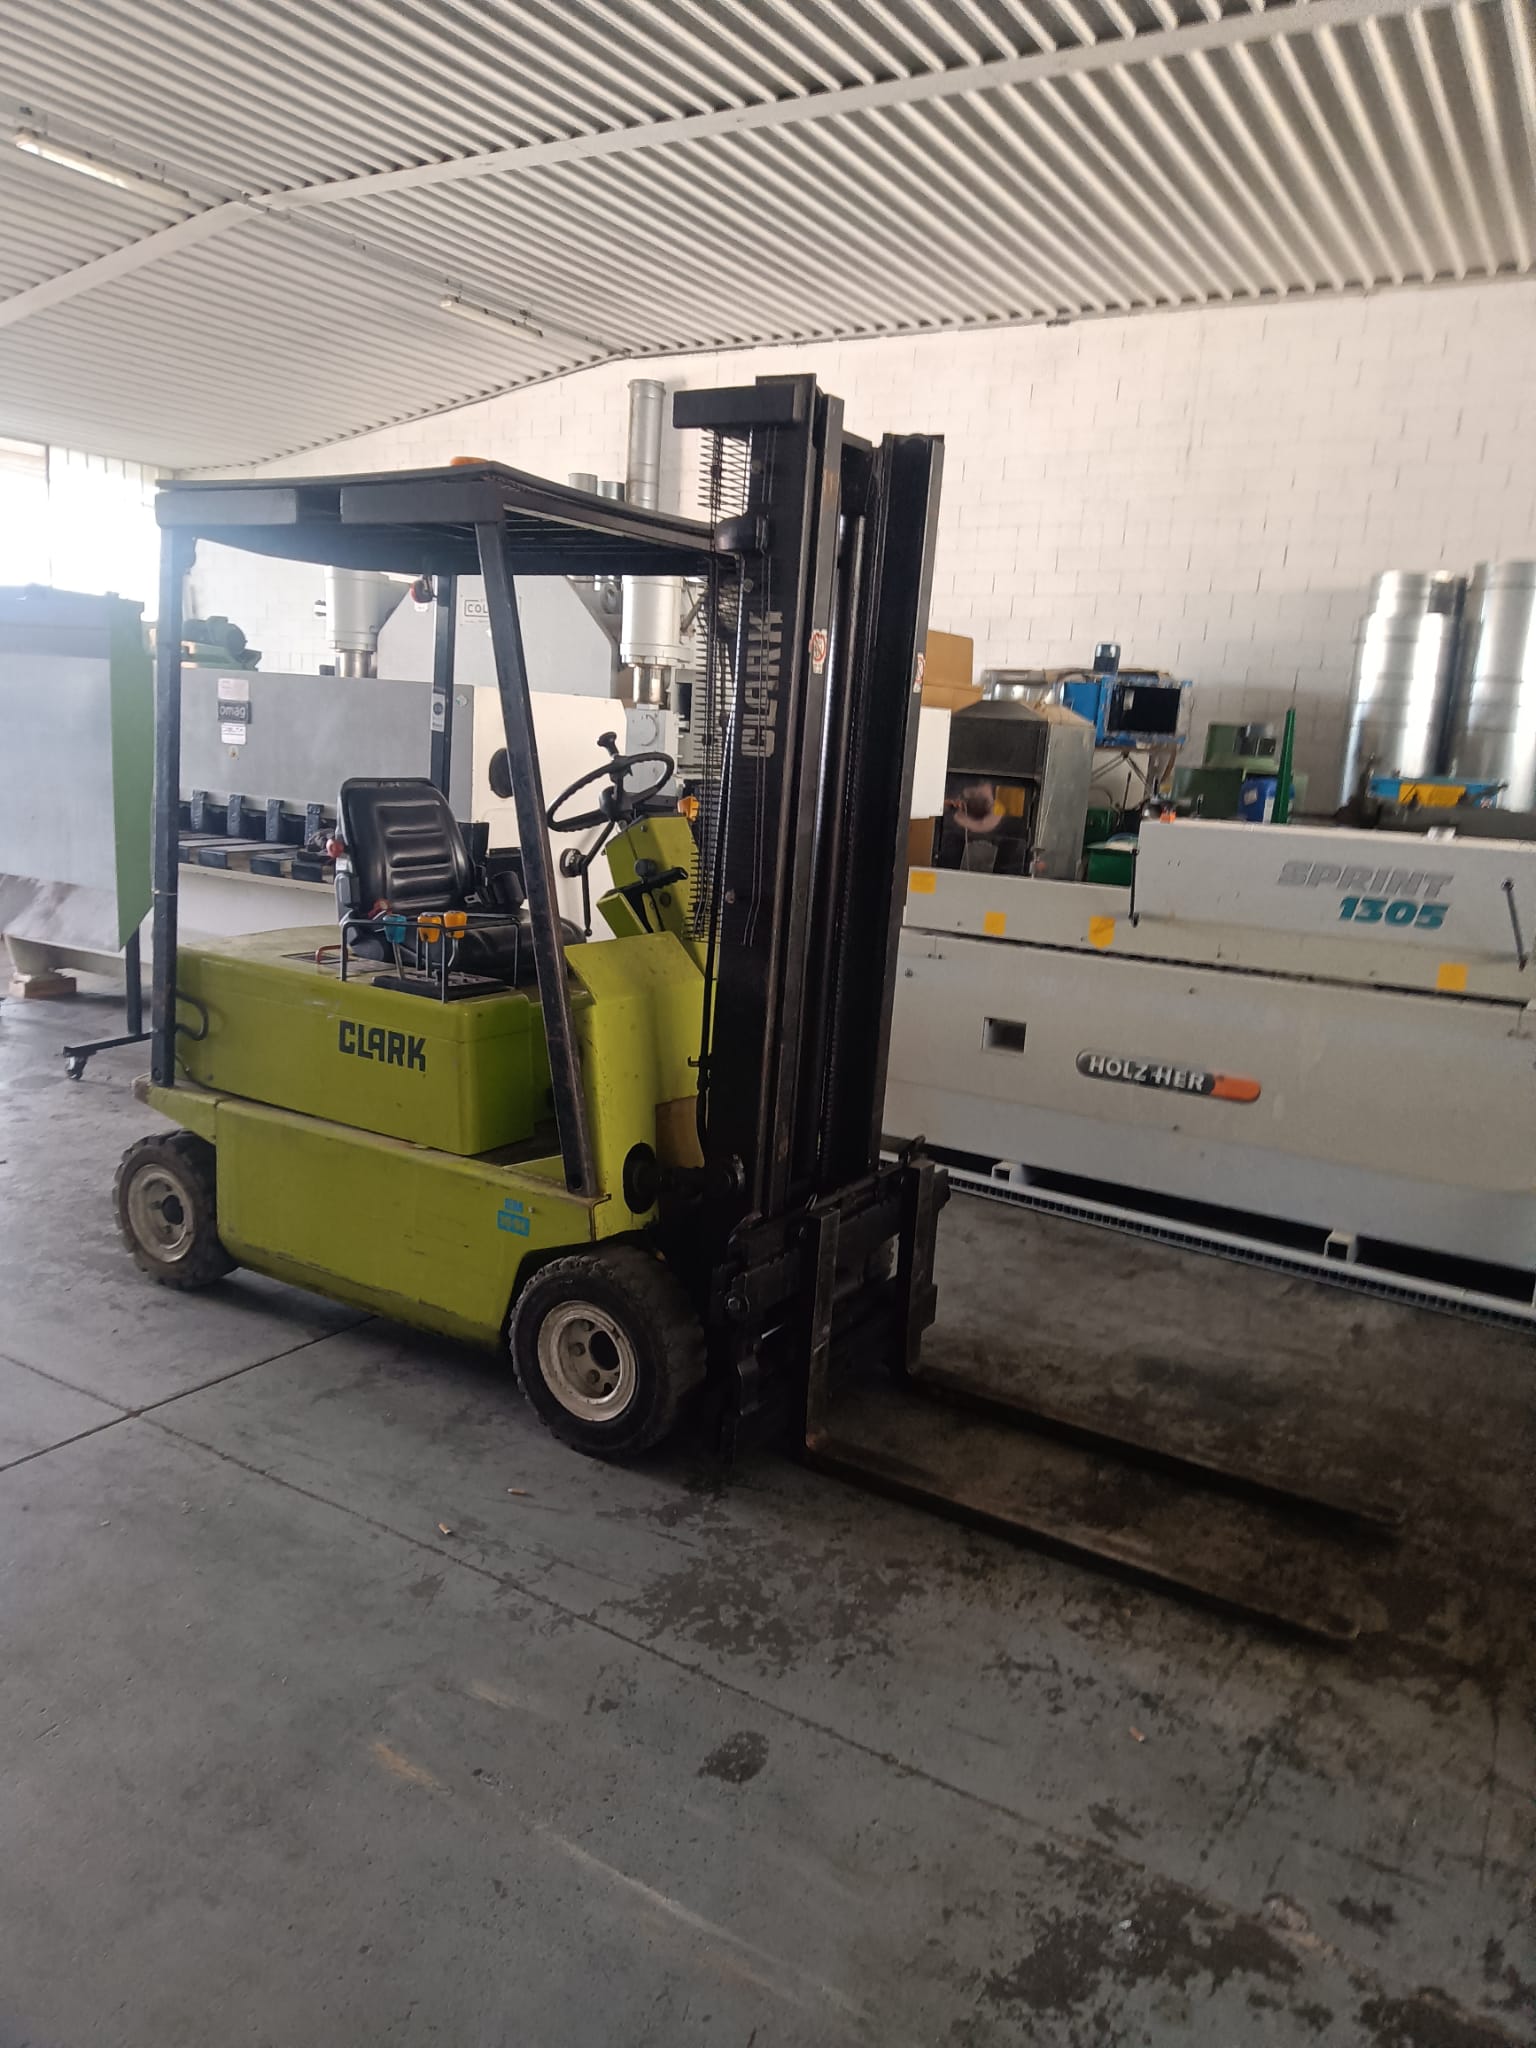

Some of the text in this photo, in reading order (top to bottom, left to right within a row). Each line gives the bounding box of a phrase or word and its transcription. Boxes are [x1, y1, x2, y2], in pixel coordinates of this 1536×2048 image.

[467, 603, 489, 614] COL
[740, 611, 784, 759] CLARK
[1277, 860, 1454, 898] SPRINT
[1338, 896, 1449, 930] 1305
[339, 1020, 427, 1073] CLARK
